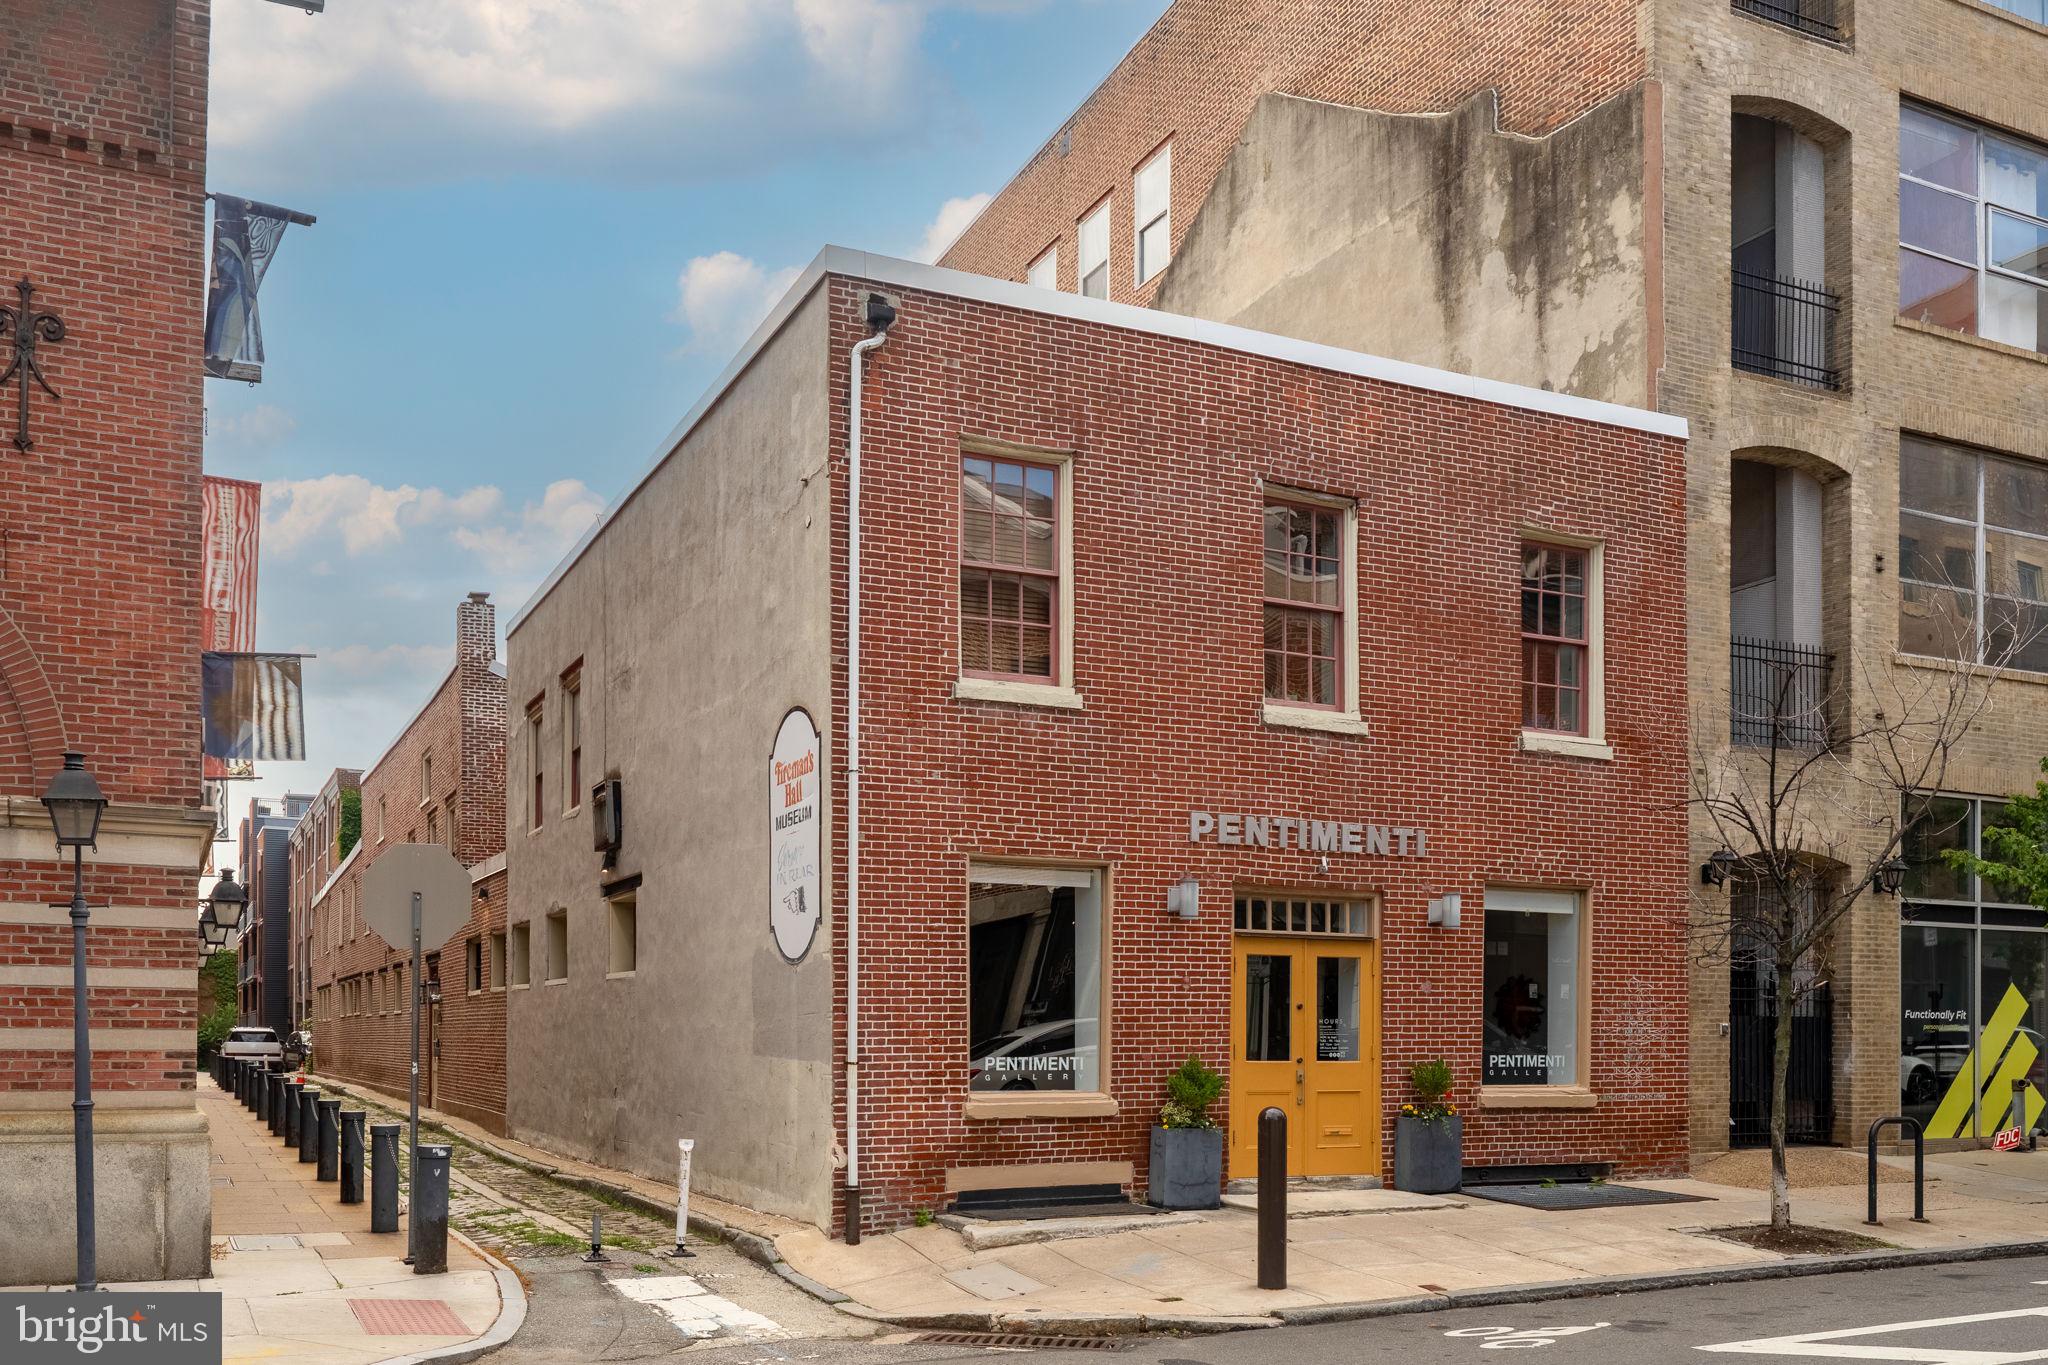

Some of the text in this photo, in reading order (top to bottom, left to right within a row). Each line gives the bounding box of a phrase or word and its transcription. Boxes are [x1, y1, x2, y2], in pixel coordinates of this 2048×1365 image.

[775, 749, 814, 786] Fireman's
[785, 780, 802, 808] Hall
[776, 805, 812, 831] MUSEUM
[1190, 811, 1426, 857] PENTIMENTI
[1904, 1009, 1967, 1021] Functionally Fit
[985, 1056, 1084, 1071] PENTIMENTI
[1489, 1054, 1565, 1067] PENTIMENTI
[984, 1073, 1084, 1081] GALLERY
[1996, 1128, 2019, 1146] FDC
